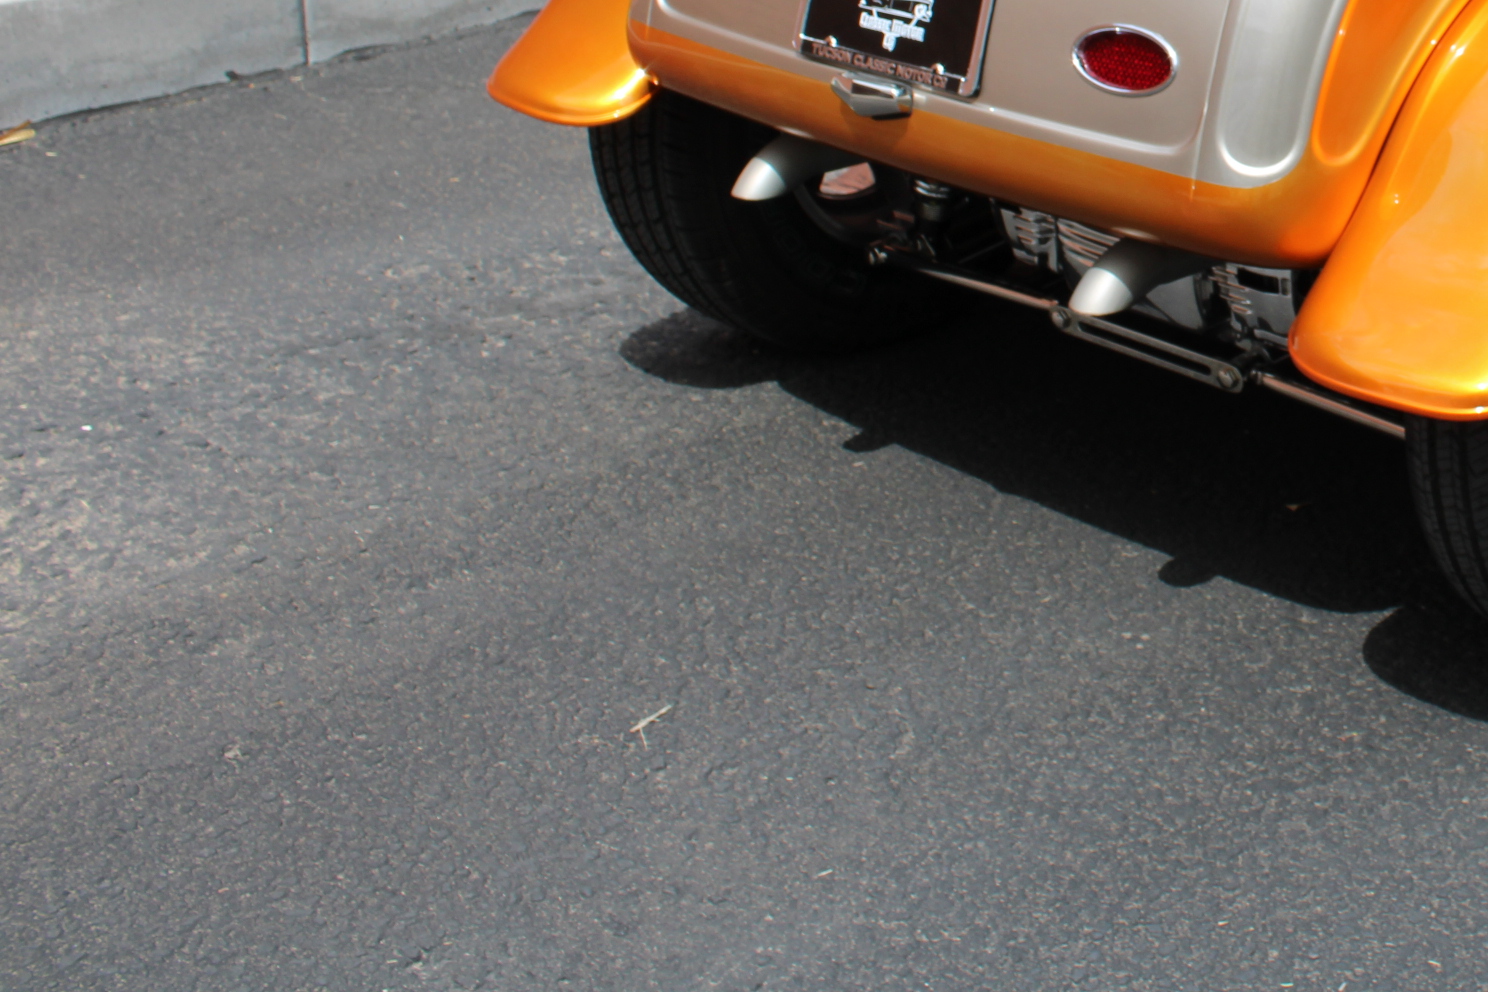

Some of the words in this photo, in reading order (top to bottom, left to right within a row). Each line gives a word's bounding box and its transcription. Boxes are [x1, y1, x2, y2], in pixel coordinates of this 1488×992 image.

[811, 43, 852, 63] TUCSON
[852, 54, 896, 75] CLASSIC
[896, 64, 933, 84] MOTOR
